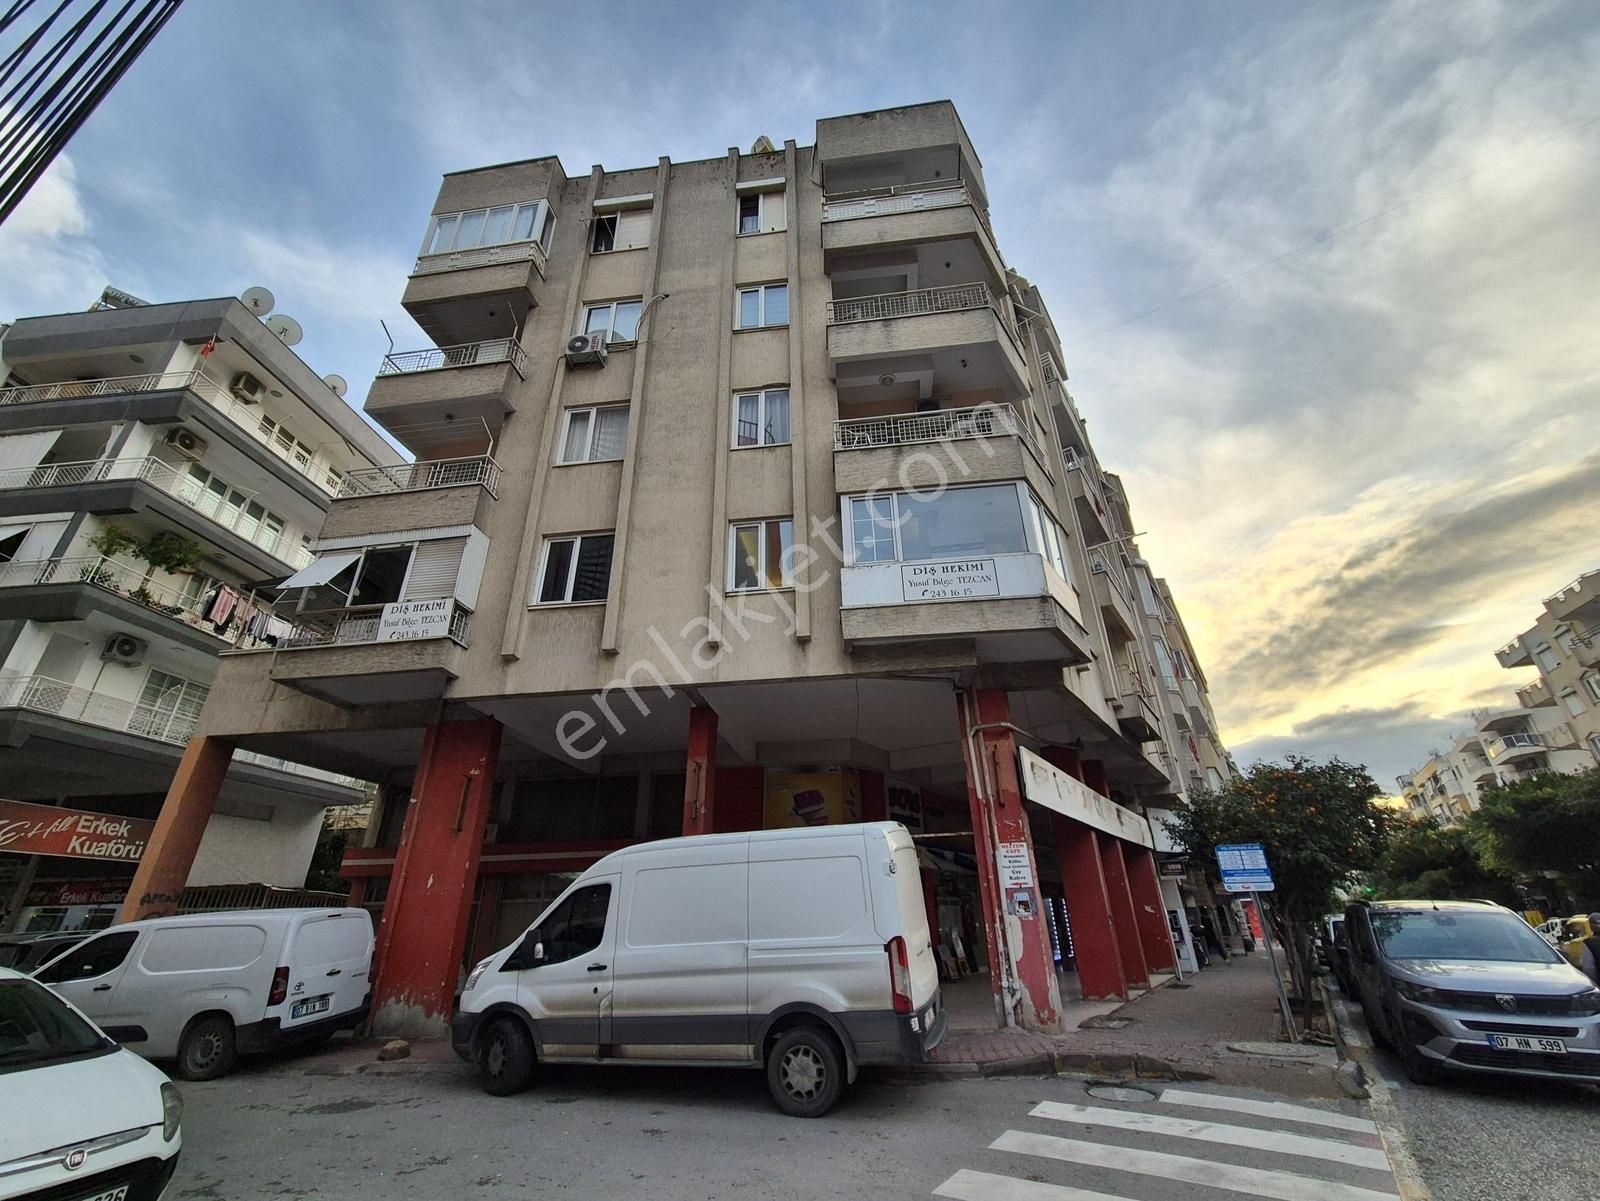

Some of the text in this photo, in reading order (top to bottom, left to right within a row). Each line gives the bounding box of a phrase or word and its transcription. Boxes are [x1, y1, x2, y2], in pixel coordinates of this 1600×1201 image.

[913, 562, 984, 576] DİŞ HEKİMİ
[908, 578, 930, 587] Yusuf
[957, 574, 992, 584] TEZCAN
[930, 588, 973, 598] 243 16 15
[391, 601, 446, 614] DİŞ HEKİMİ
[420, 614, 448, 625] TEZCAN
[75, 815, 133, 838] Erkek
[66, 835, 144, 859] Kuaförü
[1495, 1036, 1562, 1052] 07 HN 599
